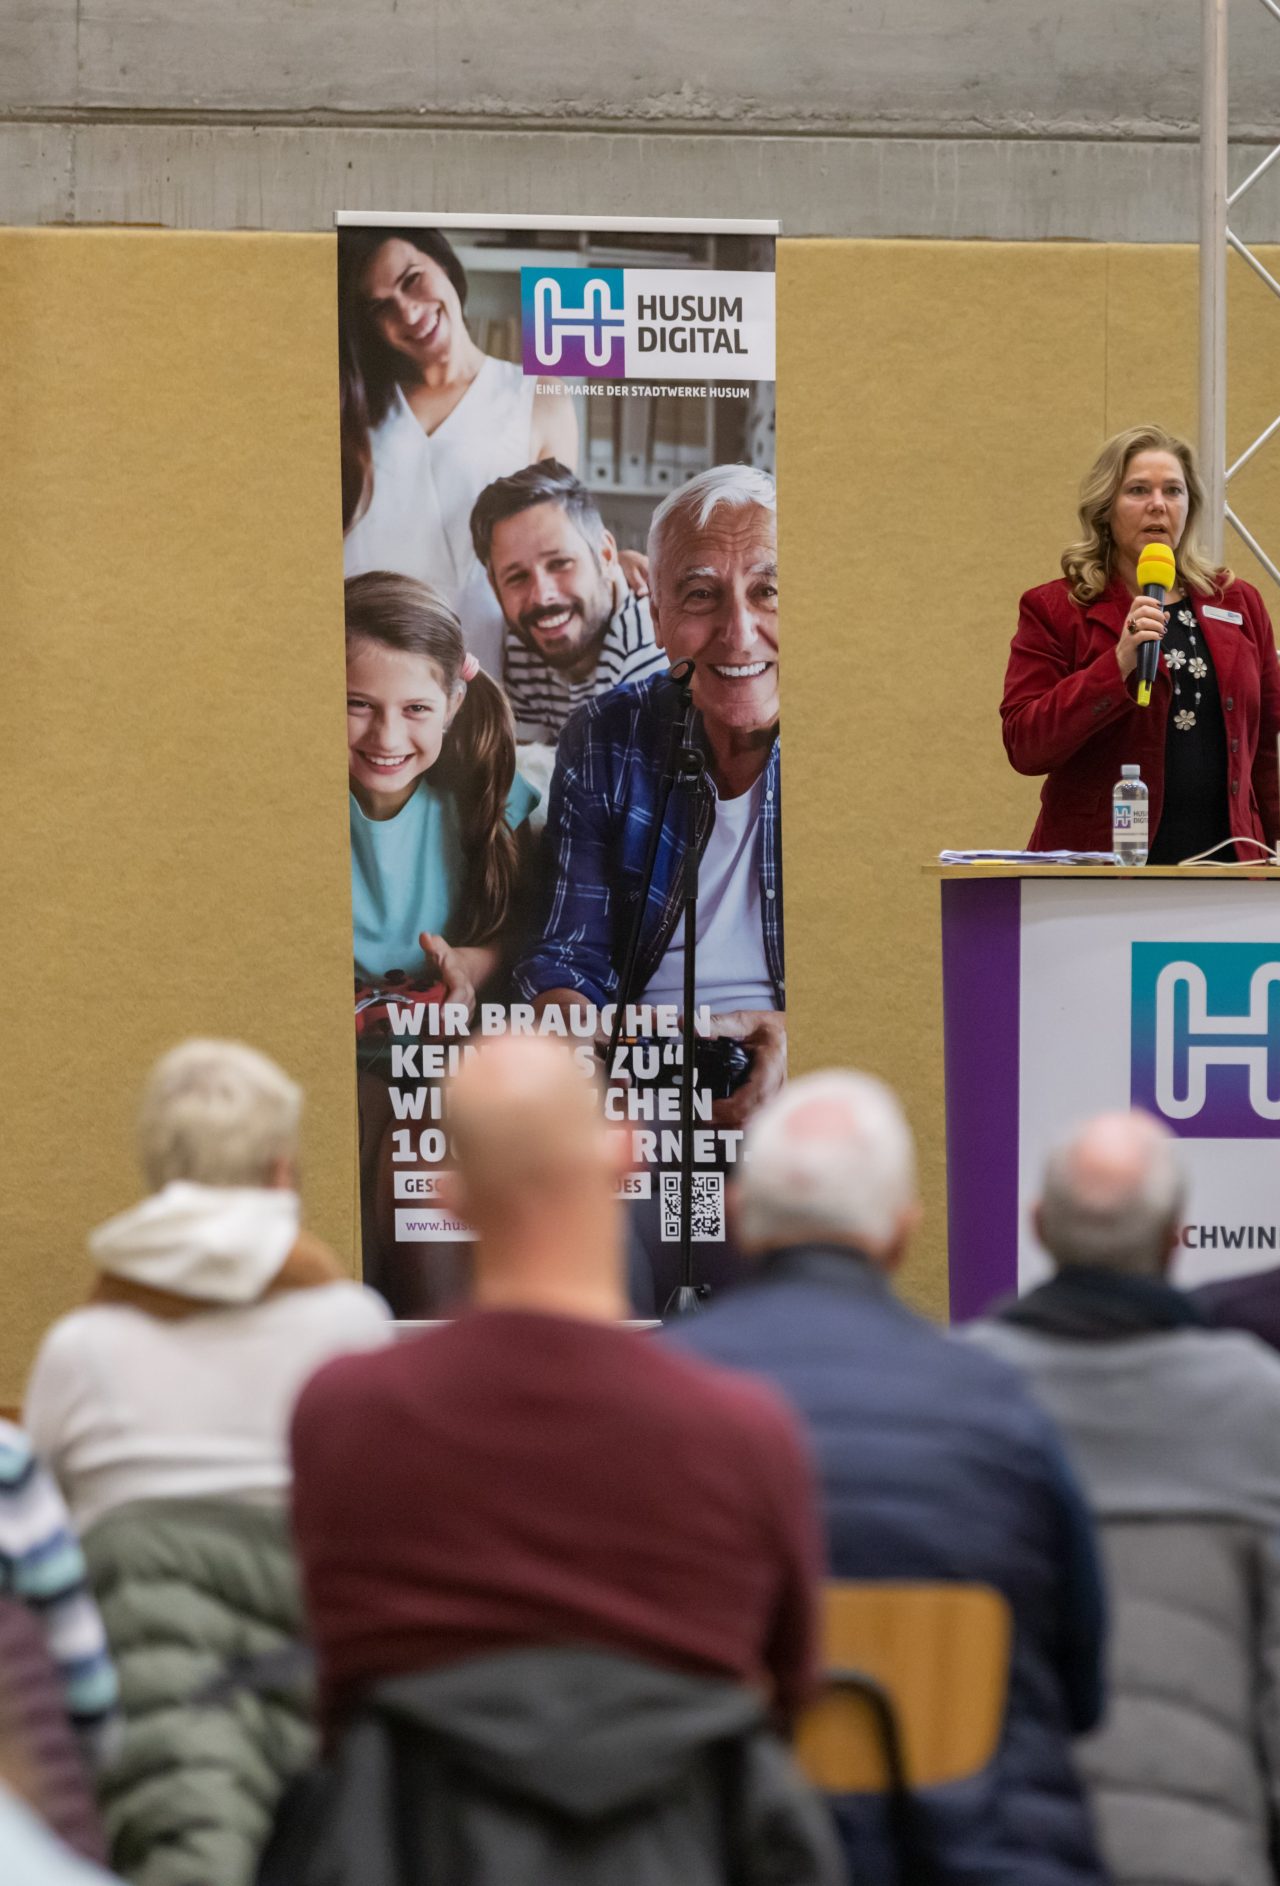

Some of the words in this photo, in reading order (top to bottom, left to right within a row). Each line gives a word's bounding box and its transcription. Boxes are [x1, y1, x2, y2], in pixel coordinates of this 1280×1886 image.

[637, 295, 743, 322] HUSUM
[638, 327, 749, 354] DIGITAL
[536, 384, 561, 395] EINE
[564, 385, 604, 396] MARKE
[606, 386, 629, 396] DER
[631, 386, 707, 398] STADTWERKE
[709, 387, 750, 399] HUSUM
[386, 1003, 471, 1036] WIR
[481, 1003, 711, 1038] BRAUCHEN
